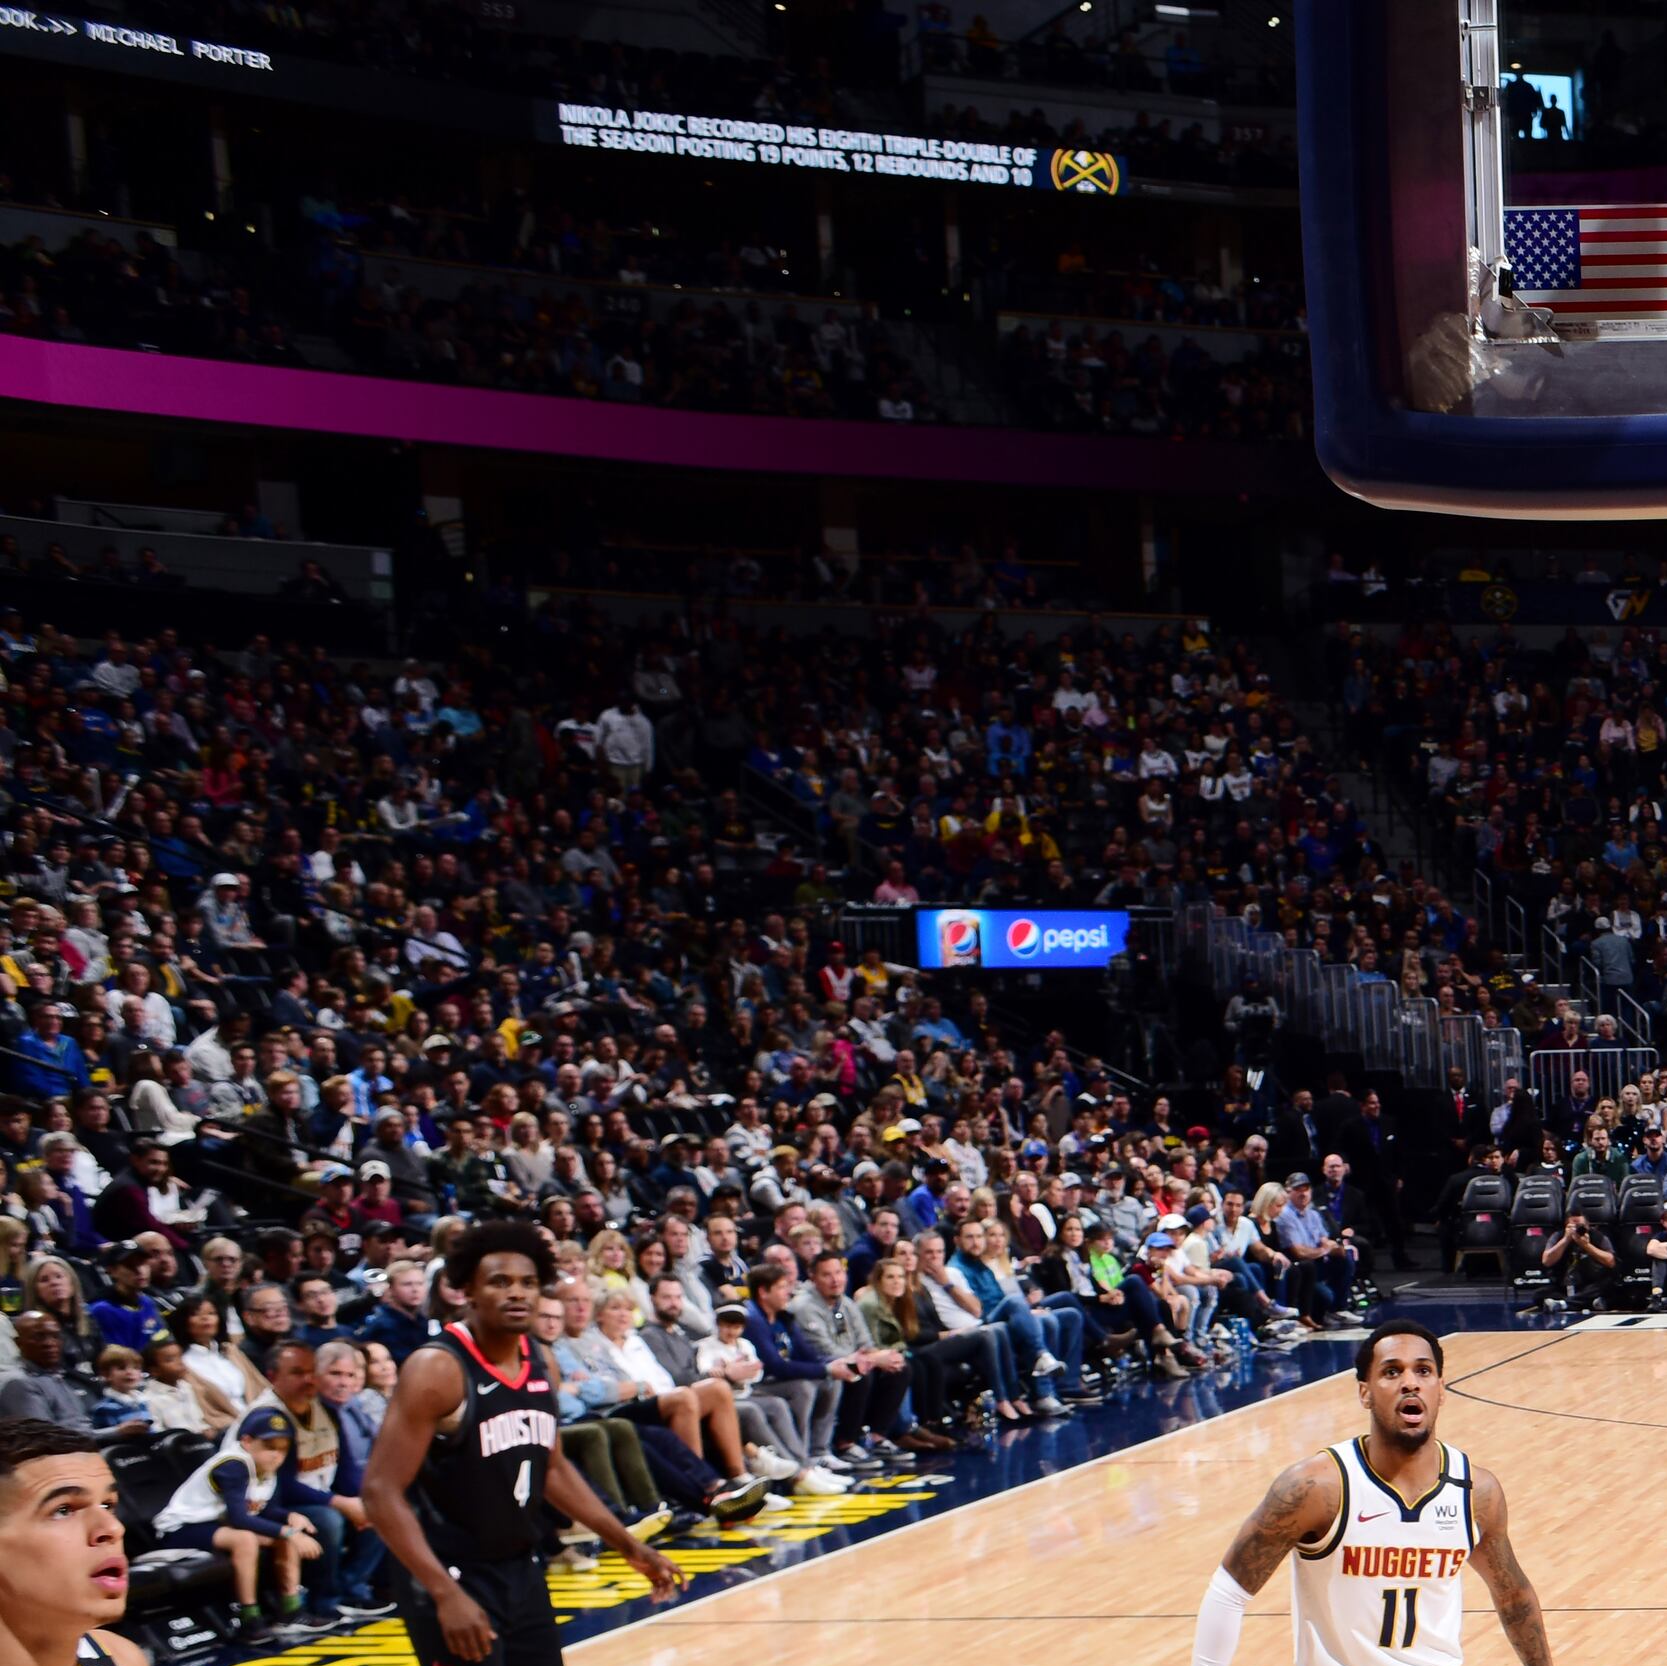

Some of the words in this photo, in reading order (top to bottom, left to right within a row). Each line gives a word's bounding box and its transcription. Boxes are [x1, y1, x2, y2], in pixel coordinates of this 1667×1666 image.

[84, 20, 185, 56] MICHAEL
[191, 40, 274, 71] PORTER
[558, 103, 632, 130] NIKOLA
[632, 110, 687, 135] JOKIC
[687, 114, 786, 144] RECORDED
[786, 125, 818, 147] HIS
[818, 128, 883, 154] EIGHTH
[883, 134, 1012, 167] TRIPLE-DOUBLE
[1012, 147, 1038, 167] OF
[559, 124, 598, 148] THE
[598, 128, 675, 155] SEASON
[676, 135, 757, 162] POSTING
[757, 144, 781, 164] 19
[782, 146, 850, 172] POINTS,
[851, 152, 875, 173] 12
[875, 155, 970, 181] REBOUNDS
[970, 164, 1010, 185] AND
[1011, 166, 1033, 187] 10
[1043, 924, 1109, 954] pepsi
[1434, 1504, 1458, 1519] WU
[1341, 1544, 1467, 1580] NUGGETS
[1377, 1586, 1422, 1649] 11
